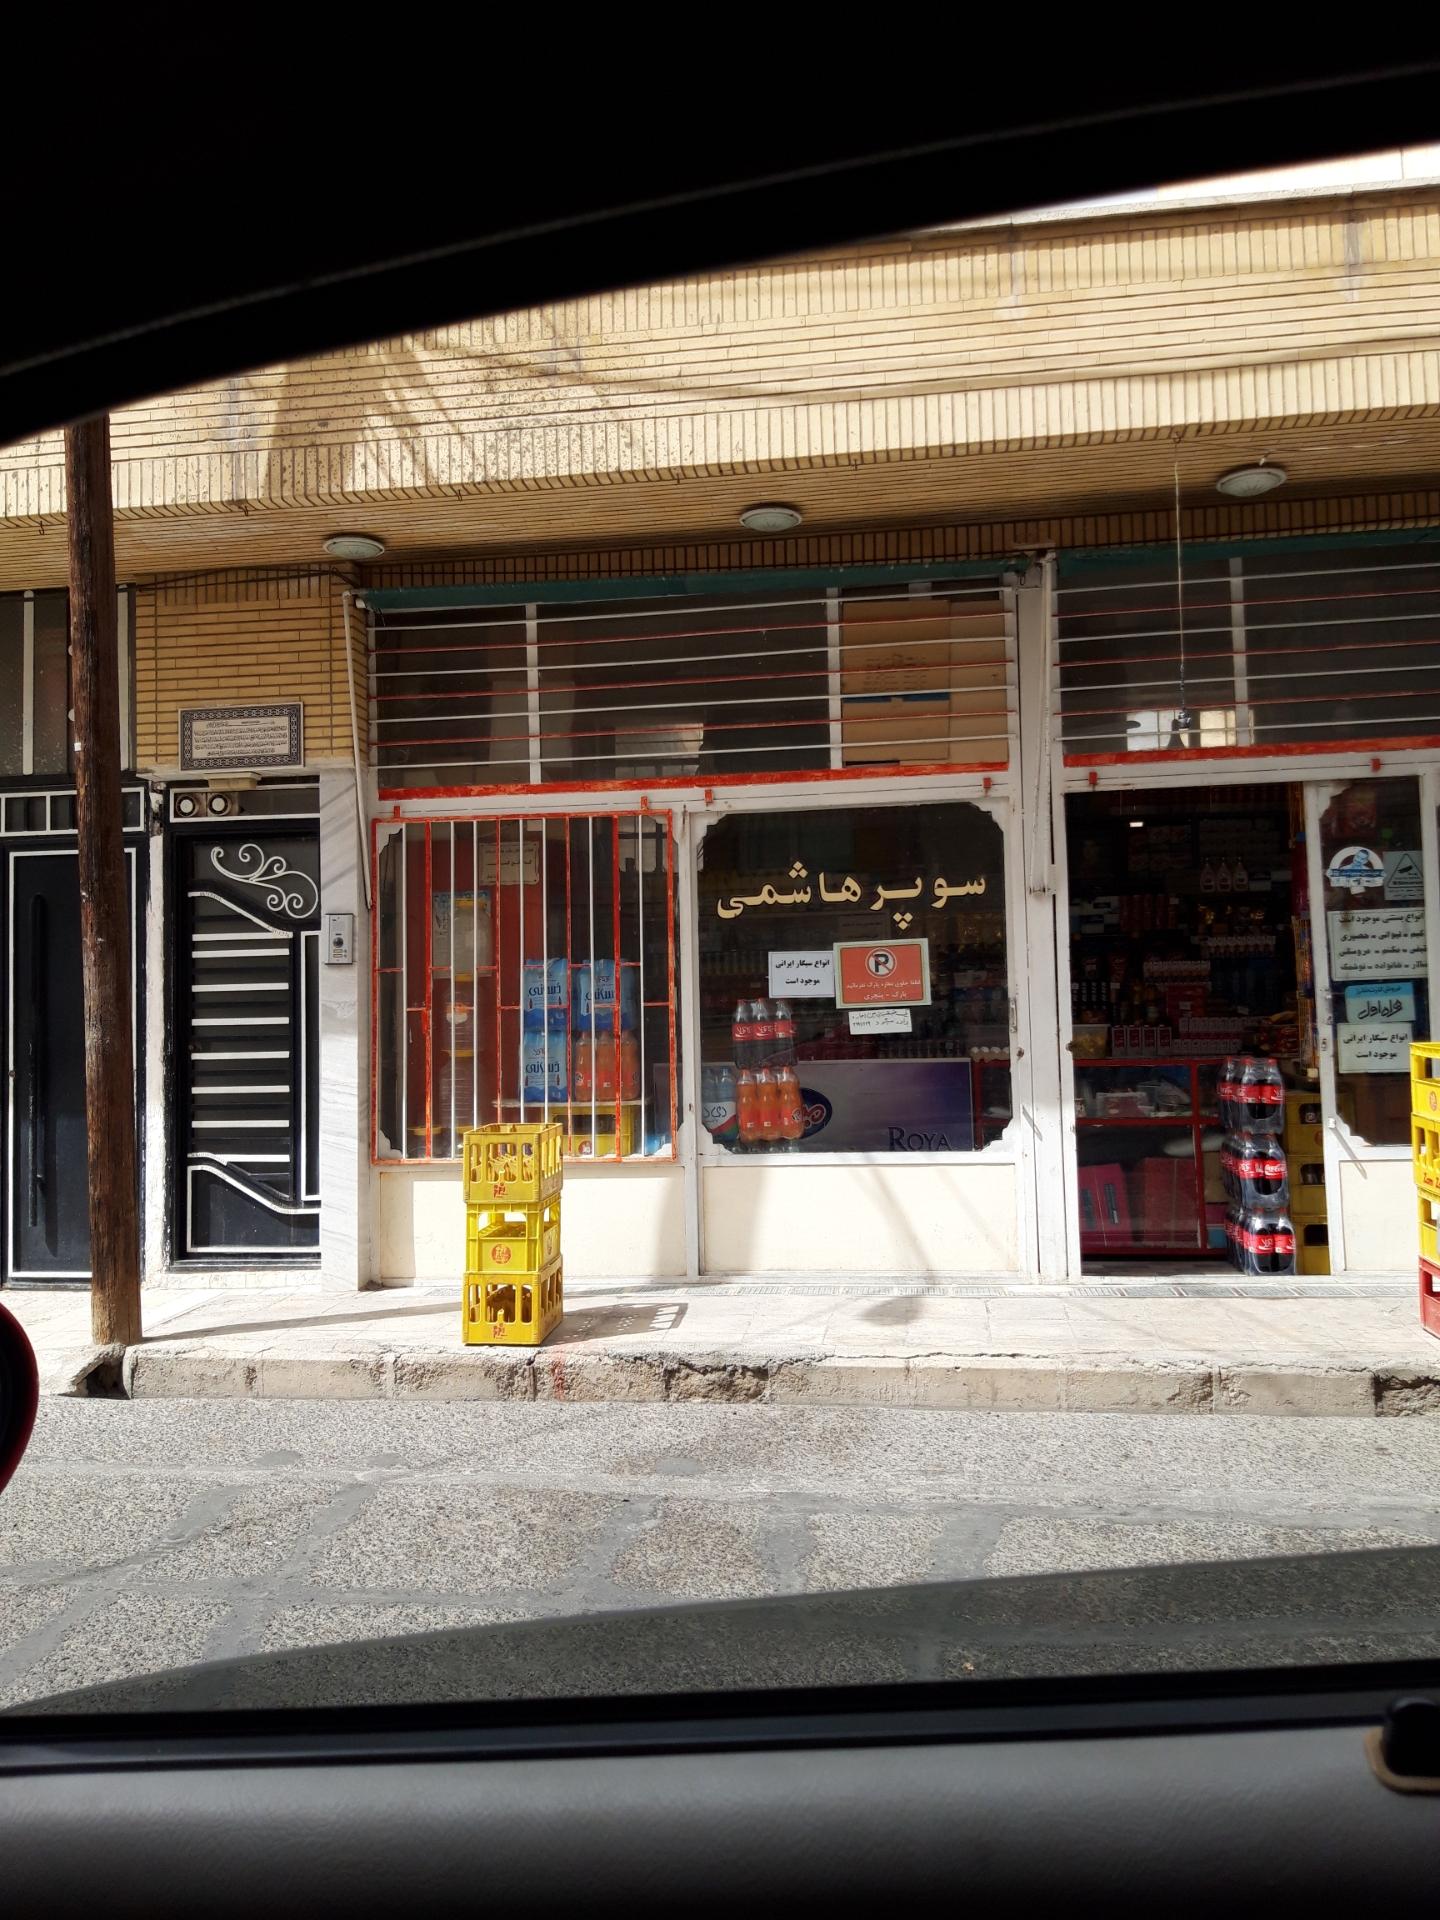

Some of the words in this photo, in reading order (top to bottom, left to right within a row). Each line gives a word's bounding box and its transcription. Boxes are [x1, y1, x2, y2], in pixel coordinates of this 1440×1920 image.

[716, 861, 863, 920] هاشمی
[868, 872, 987, 930] سوپر
[775, 959, 795, 969] ایرانی
[796, 959, 813, 969] سیگار
[814, 958, 830, 969] انواع
[785, 977, 799, 985] است
[800, 977, 821, 986] موجود
[1343, 1032, 1366, 1044] ایرانی
[1368, 1032, 1388, 1043] سیگار
[1373, 1051, 1397, 1060] موجود
